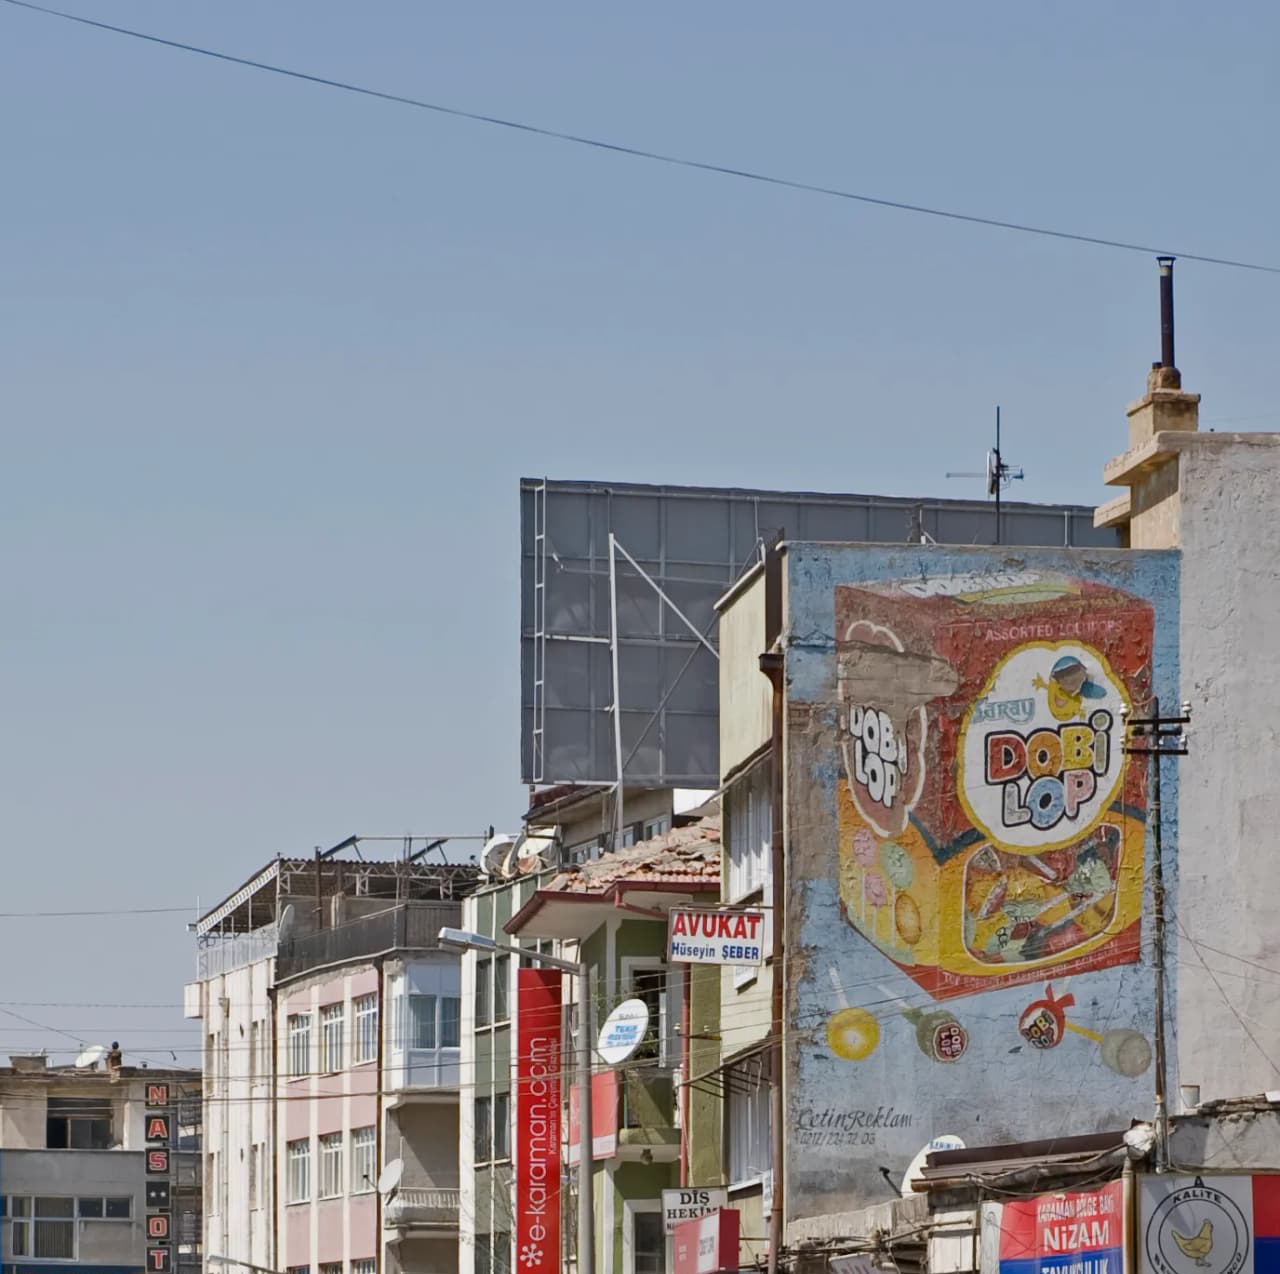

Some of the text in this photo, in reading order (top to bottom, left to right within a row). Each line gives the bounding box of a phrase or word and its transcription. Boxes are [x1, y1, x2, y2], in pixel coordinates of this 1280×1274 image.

[1001, 768, 1098, 832] LOP
[673, 912, 761, 940] AVUKAT
[671, 942, 760, 961] Hüseyin ŞEBER
[680, 1189, 710, 1206] DİŞ
